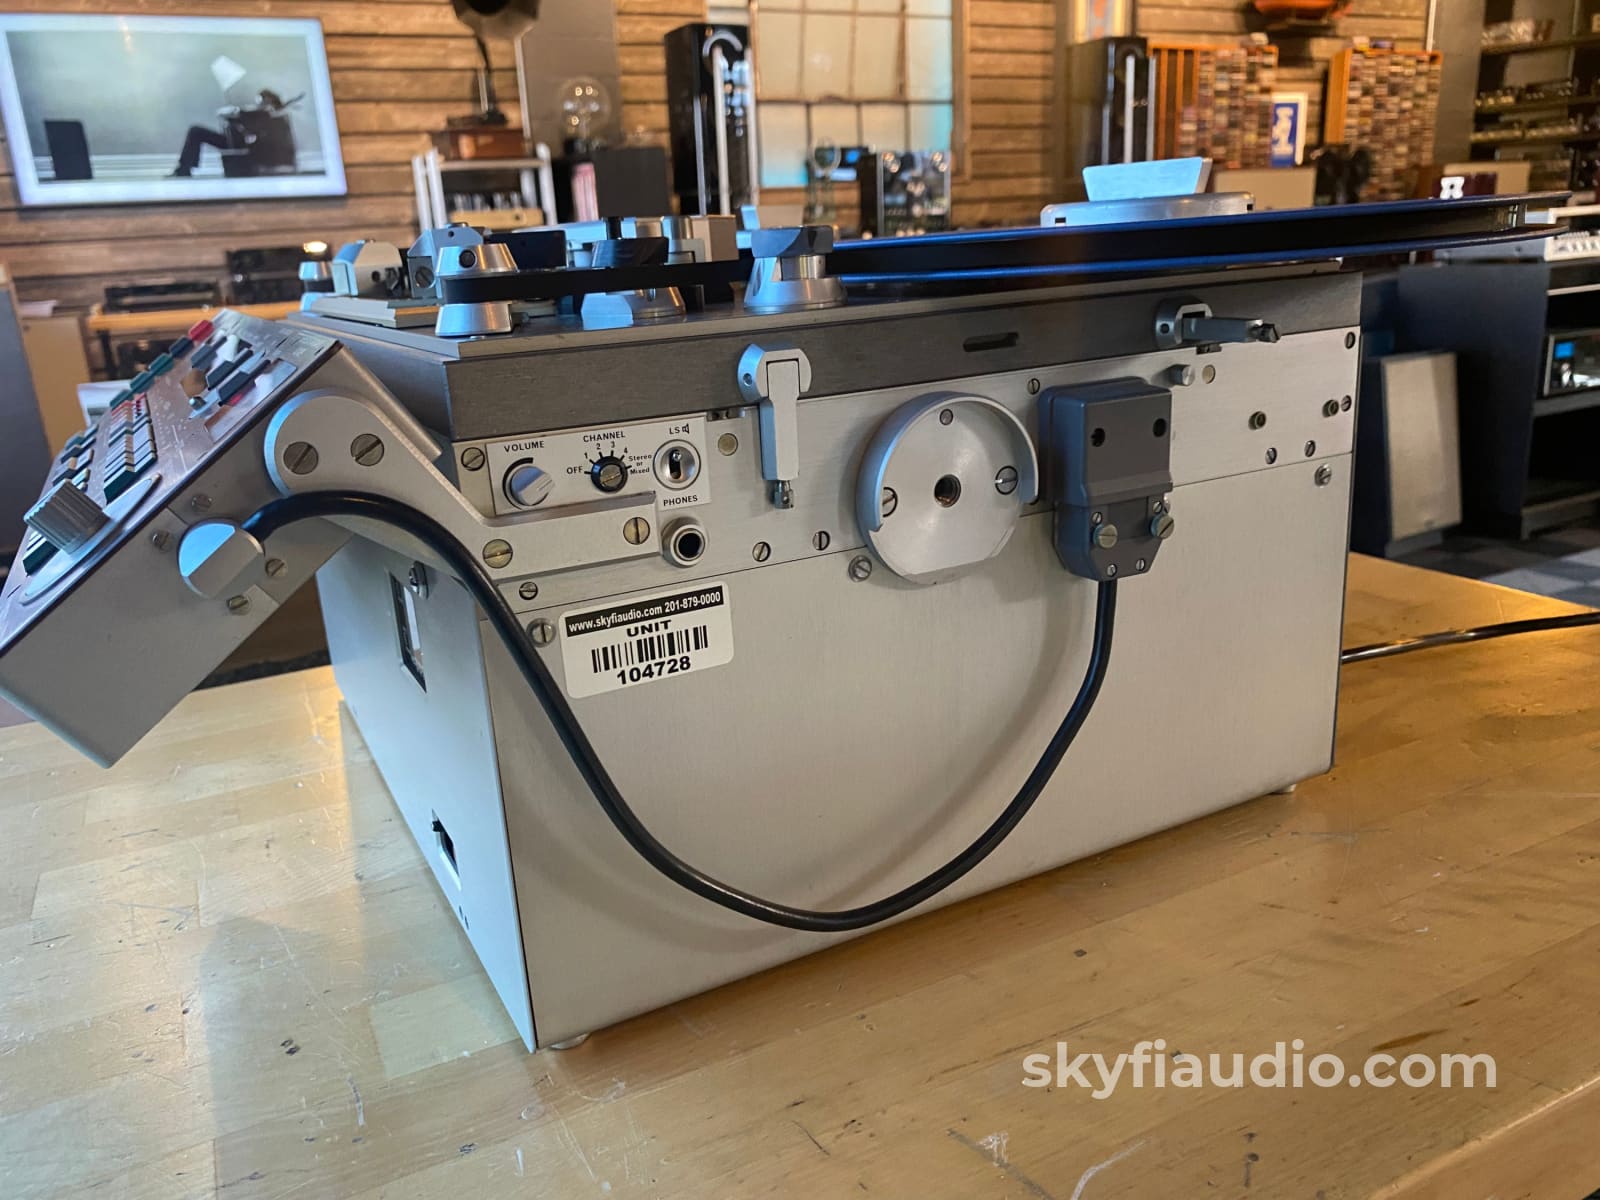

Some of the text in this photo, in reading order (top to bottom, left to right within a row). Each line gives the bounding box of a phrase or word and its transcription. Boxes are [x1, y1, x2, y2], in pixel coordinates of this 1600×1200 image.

[669, 426, 680, 435] LS
[583, 431, 626, 443] CHANNEL
[504, 440, 545, 453] VOLUME
[611, 441, 616, 449] 3
[628, 454, 652, 462] Stereo
[566, 465, 583, 475] OFF
[630, 467, 650, 475] Mixed
[663, 494, 698, 507] PHONES
[568, 591, 721, 633] www.skyfiaudio.com 201-879-0000
[626, 619, 672, 638] UNIT
[617, 655, 691, 685] 104728
